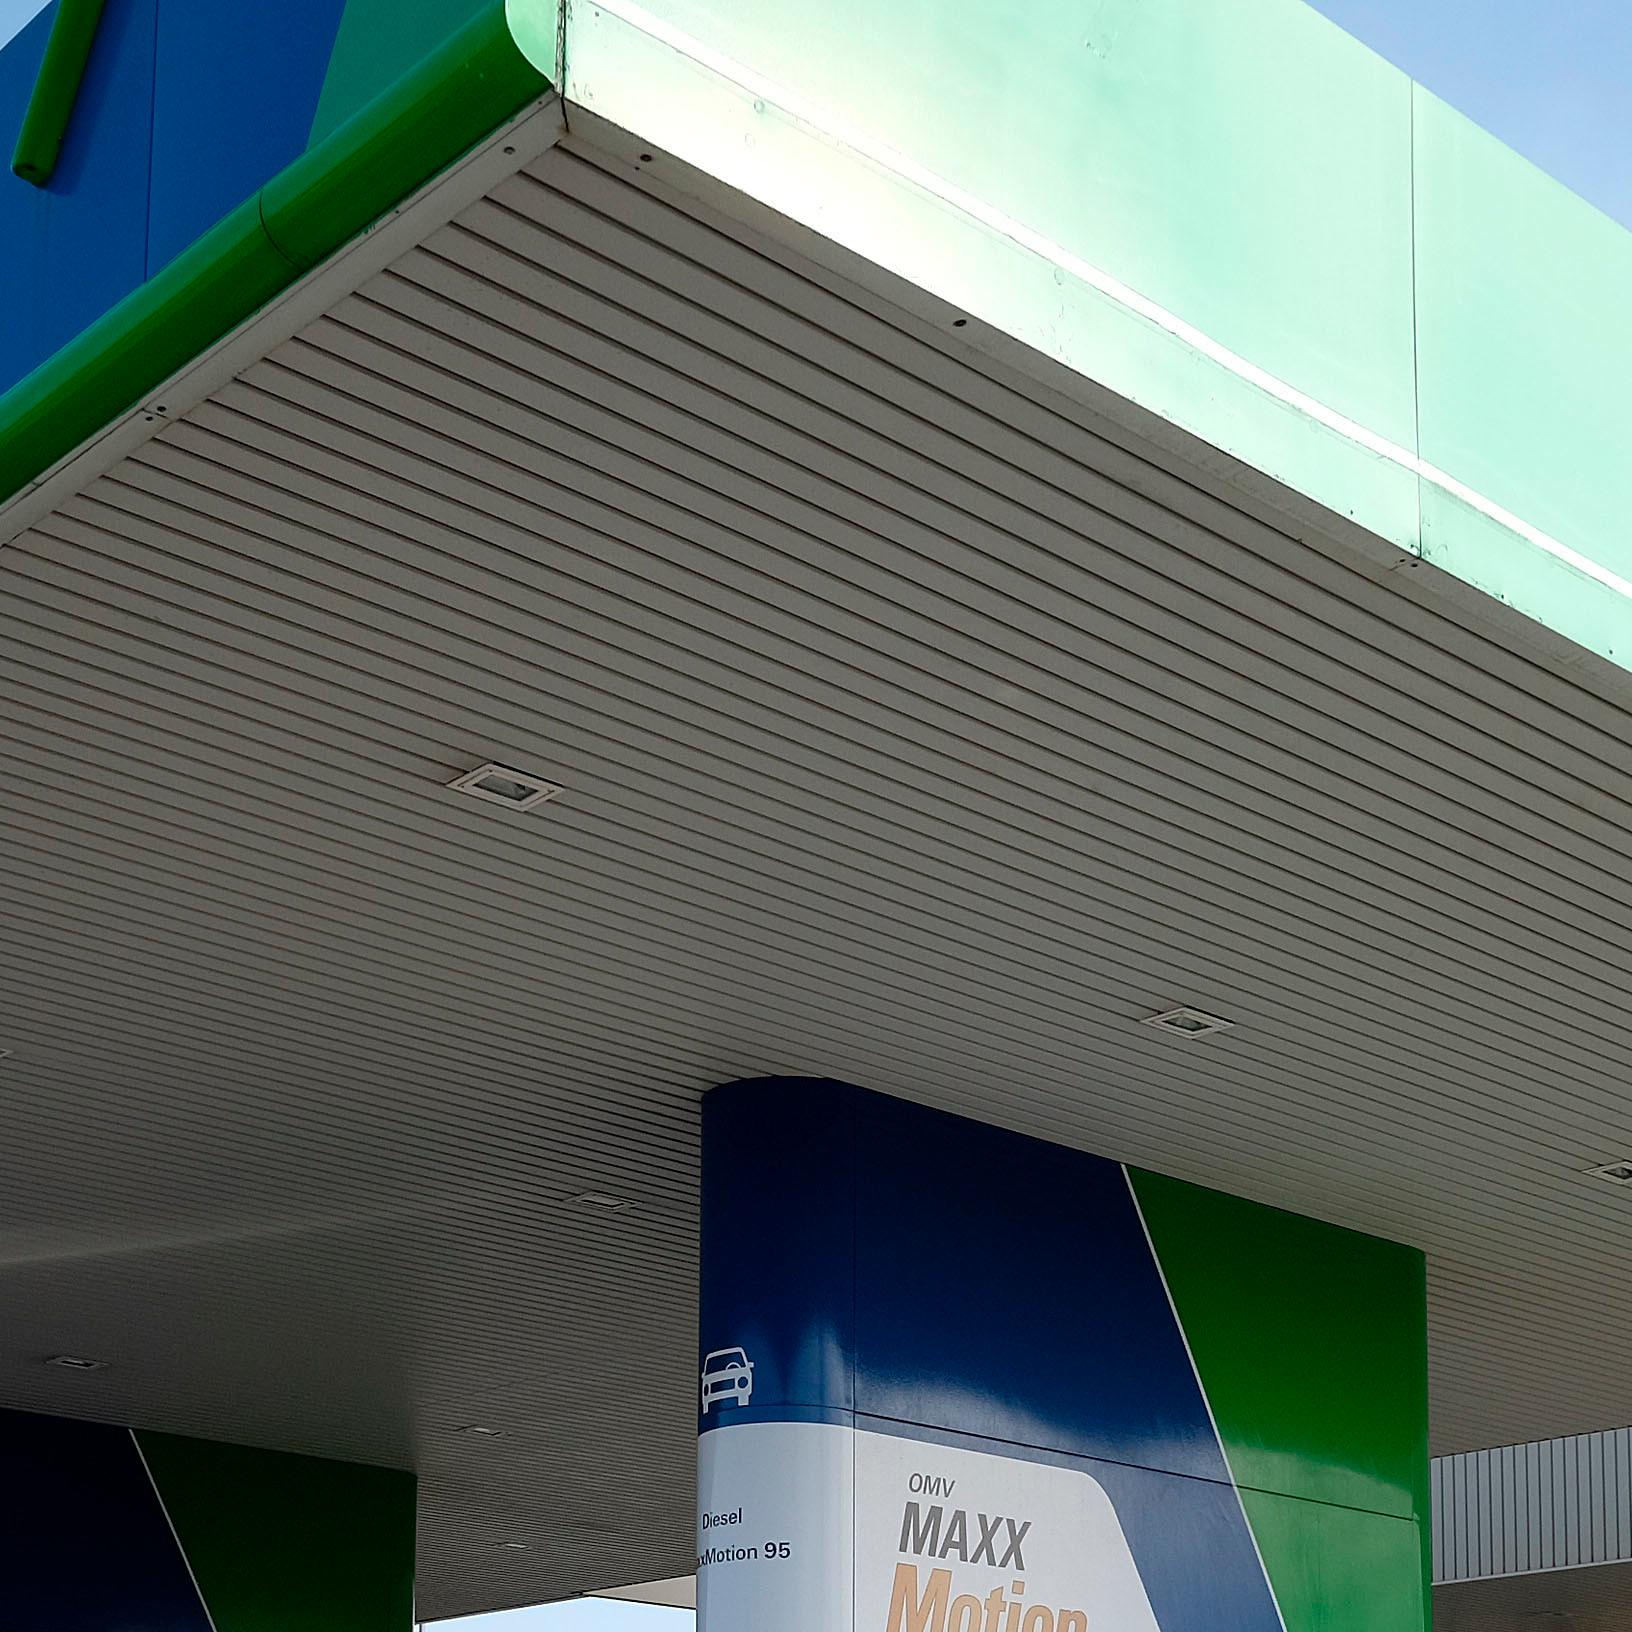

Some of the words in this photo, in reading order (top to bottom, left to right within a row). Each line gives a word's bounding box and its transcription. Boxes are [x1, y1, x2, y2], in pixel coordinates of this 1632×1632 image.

[908, 1473, 956, 1498] OMV
[702, 1507, 743, 1530] Diesel
[899, 1501, 1032, 1571] MAXX
[764, 1542, 791, 1559] 95
